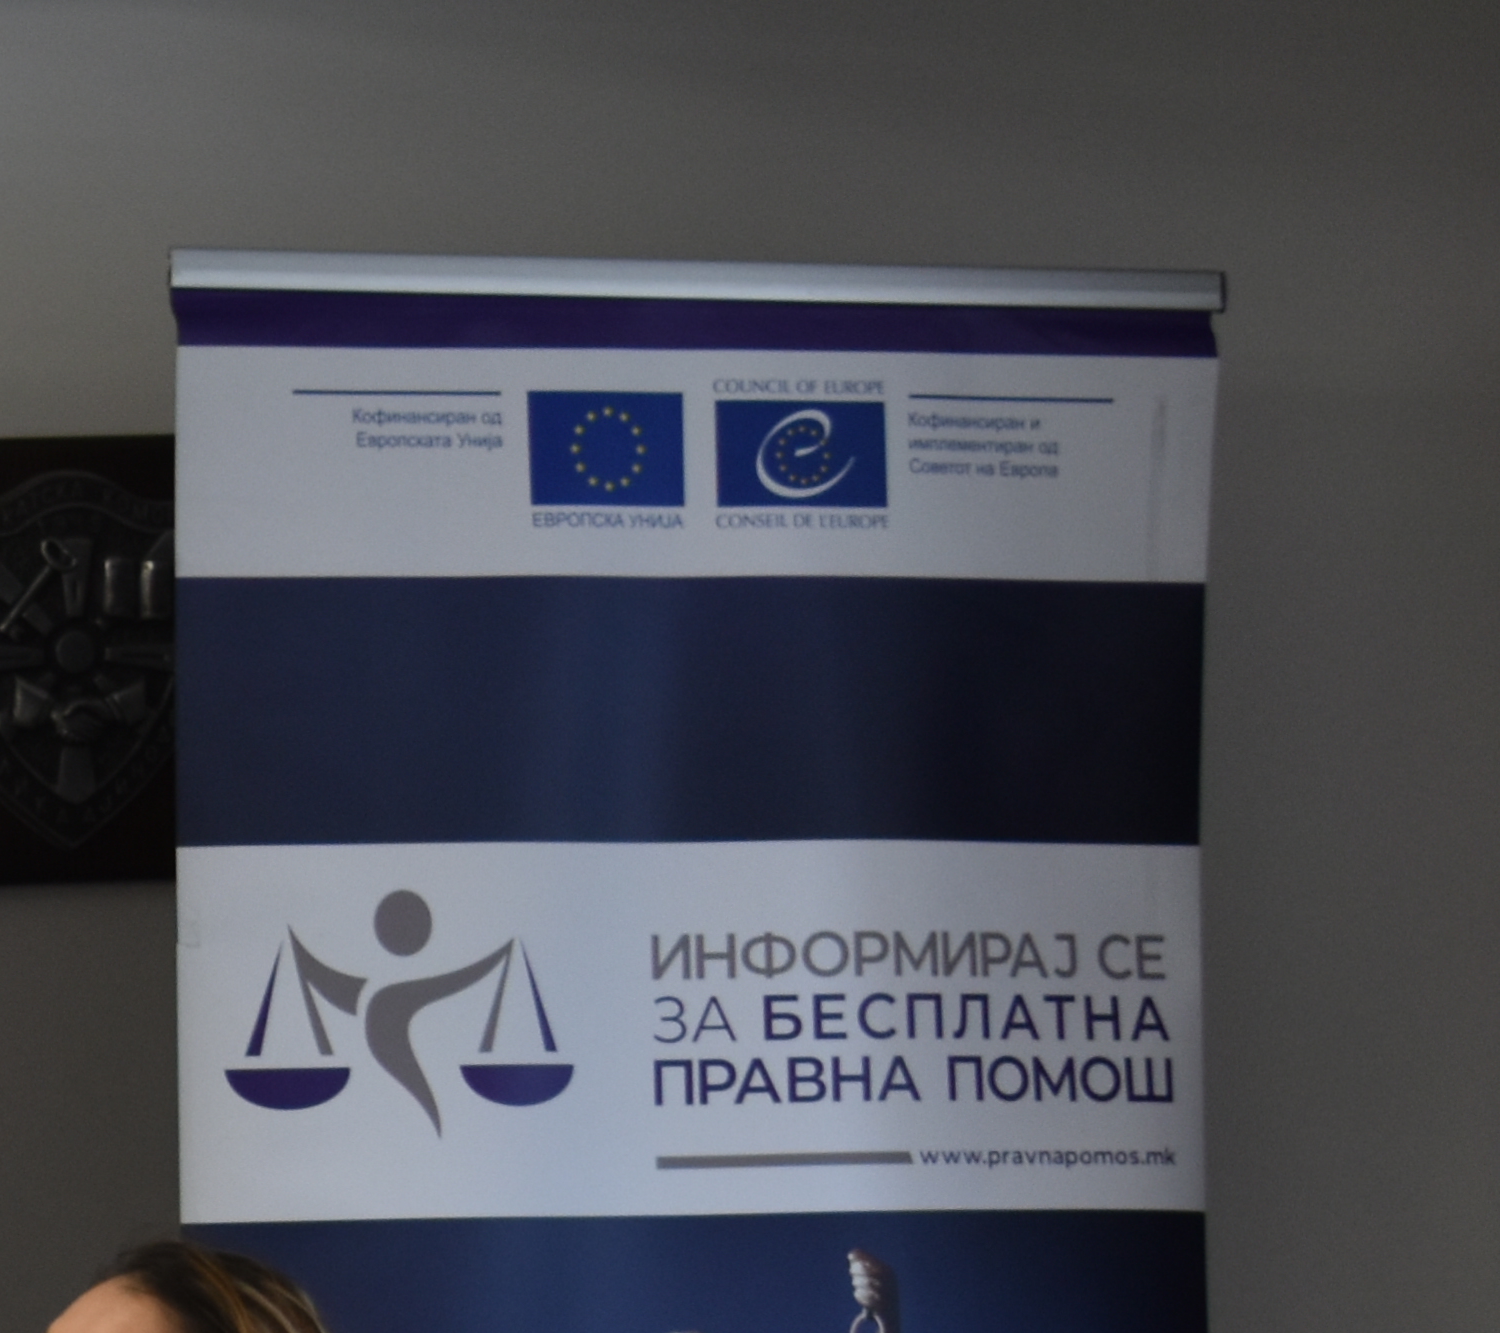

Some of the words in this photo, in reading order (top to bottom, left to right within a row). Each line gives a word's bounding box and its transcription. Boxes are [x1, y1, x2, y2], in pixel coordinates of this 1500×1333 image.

[712, 379, 791, 394] COUNCIL
[796, 380, 819, 394] OF
[824, 381, 884, 395] EUROPE
[352, 409, 476, 426] Кофинансиран
[482, 411, 502, 425] од
[908, 412, 1024, 431] Кофинансиран
[1029, 418, 1040, 431] и
[356, 433, 451, 450] Европската
[456, 433, 503, 450] Унија
[908, 437, 1033, 456] имплементиран
[1038, 441, 1059, 456] од
[909, 458, 970, 476] Советот
[975, 463, 994, 476] на
[1000, 462, 1059, 478] Европа
[532, 513, 625, 528] ЕВРОПСКА
[629, 513, 683, 529] УНИЈА
[716, 514, 788, 529] CONSEIL
[794, 514, 814, 528] DE
[652, 929, 1086, 982] ИНФОРМИРАЈ
[1097, 933, 1167, 981] СЕ
[653, 995, 737, 1044] ЗА
[764, 992, 1172, 1043] БЕСПЛАТНА
[653, 1054, 922, 1106] ПРАВНА
[947, 1055, 1176, 1105] ПОМОШ
[920, 1148, 1177, 1168] www.pravnapomos.mk
